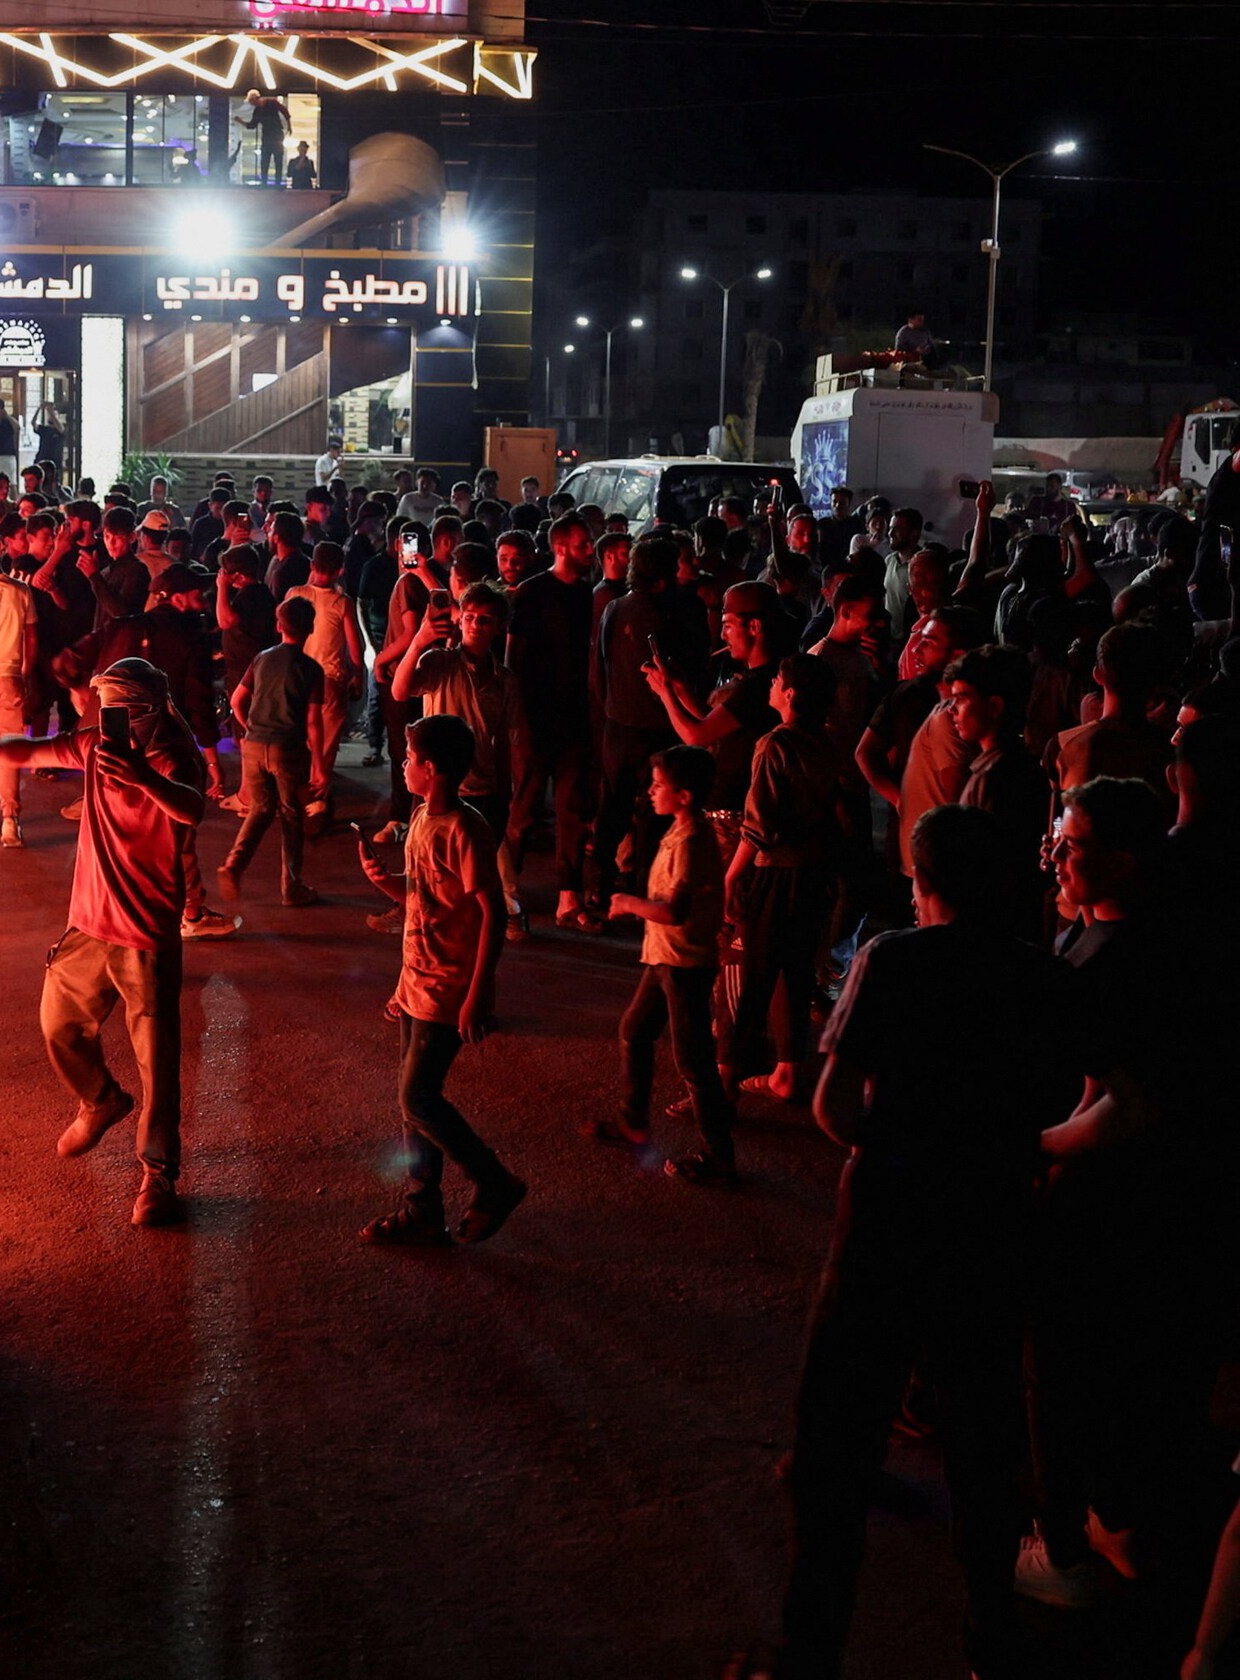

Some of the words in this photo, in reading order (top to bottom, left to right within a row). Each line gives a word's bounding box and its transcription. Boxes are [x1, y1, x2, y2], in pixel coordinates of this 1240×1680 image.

[156, 268, 259, 310] مندي
[277, 274, 305, 311] و
[322, 270, 428, 313] مطبخ
